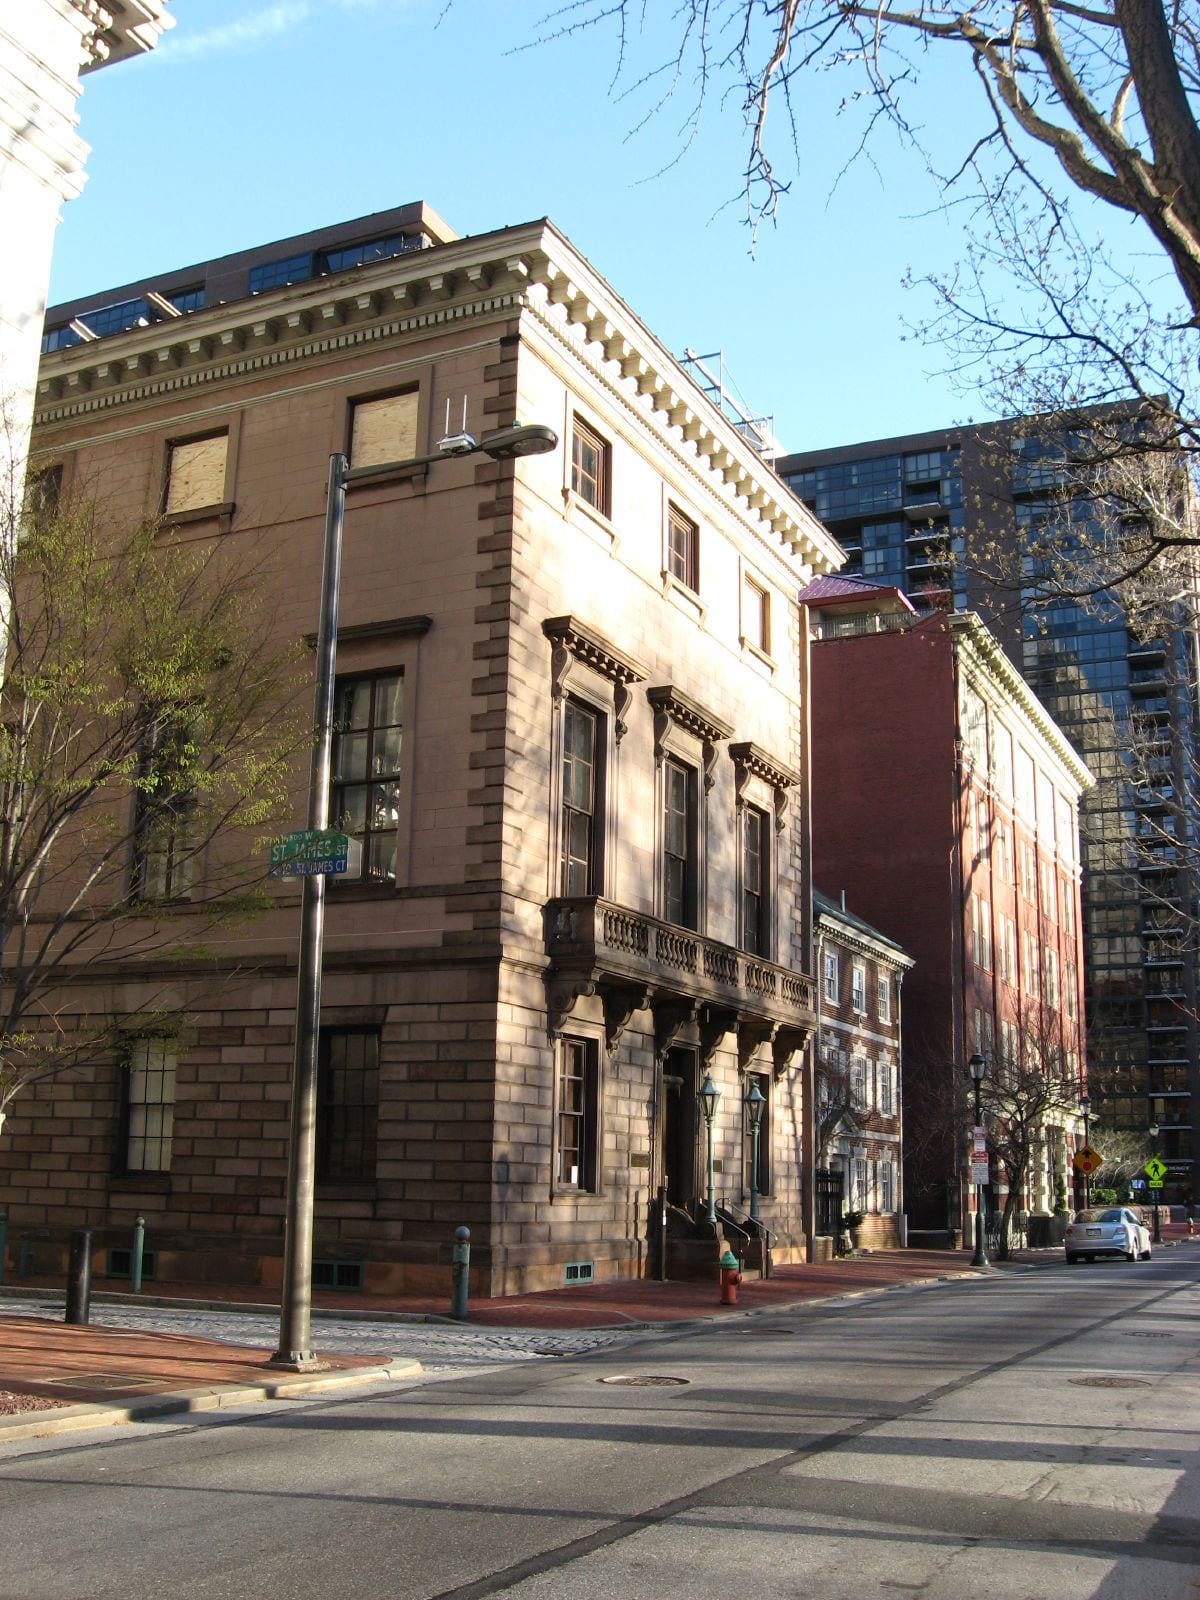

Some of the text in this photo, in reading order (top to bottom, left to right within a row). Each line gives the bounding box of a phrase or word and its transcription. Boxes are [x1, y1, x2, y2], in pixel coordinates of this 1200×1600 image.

[305, 831, 314, 841] W
[295, 840, 332, 859] JAMES
[336, 844, 347, 856] ST
[308, 860, 334, 873] JAMES
[335, 859, 347, 871] CT
